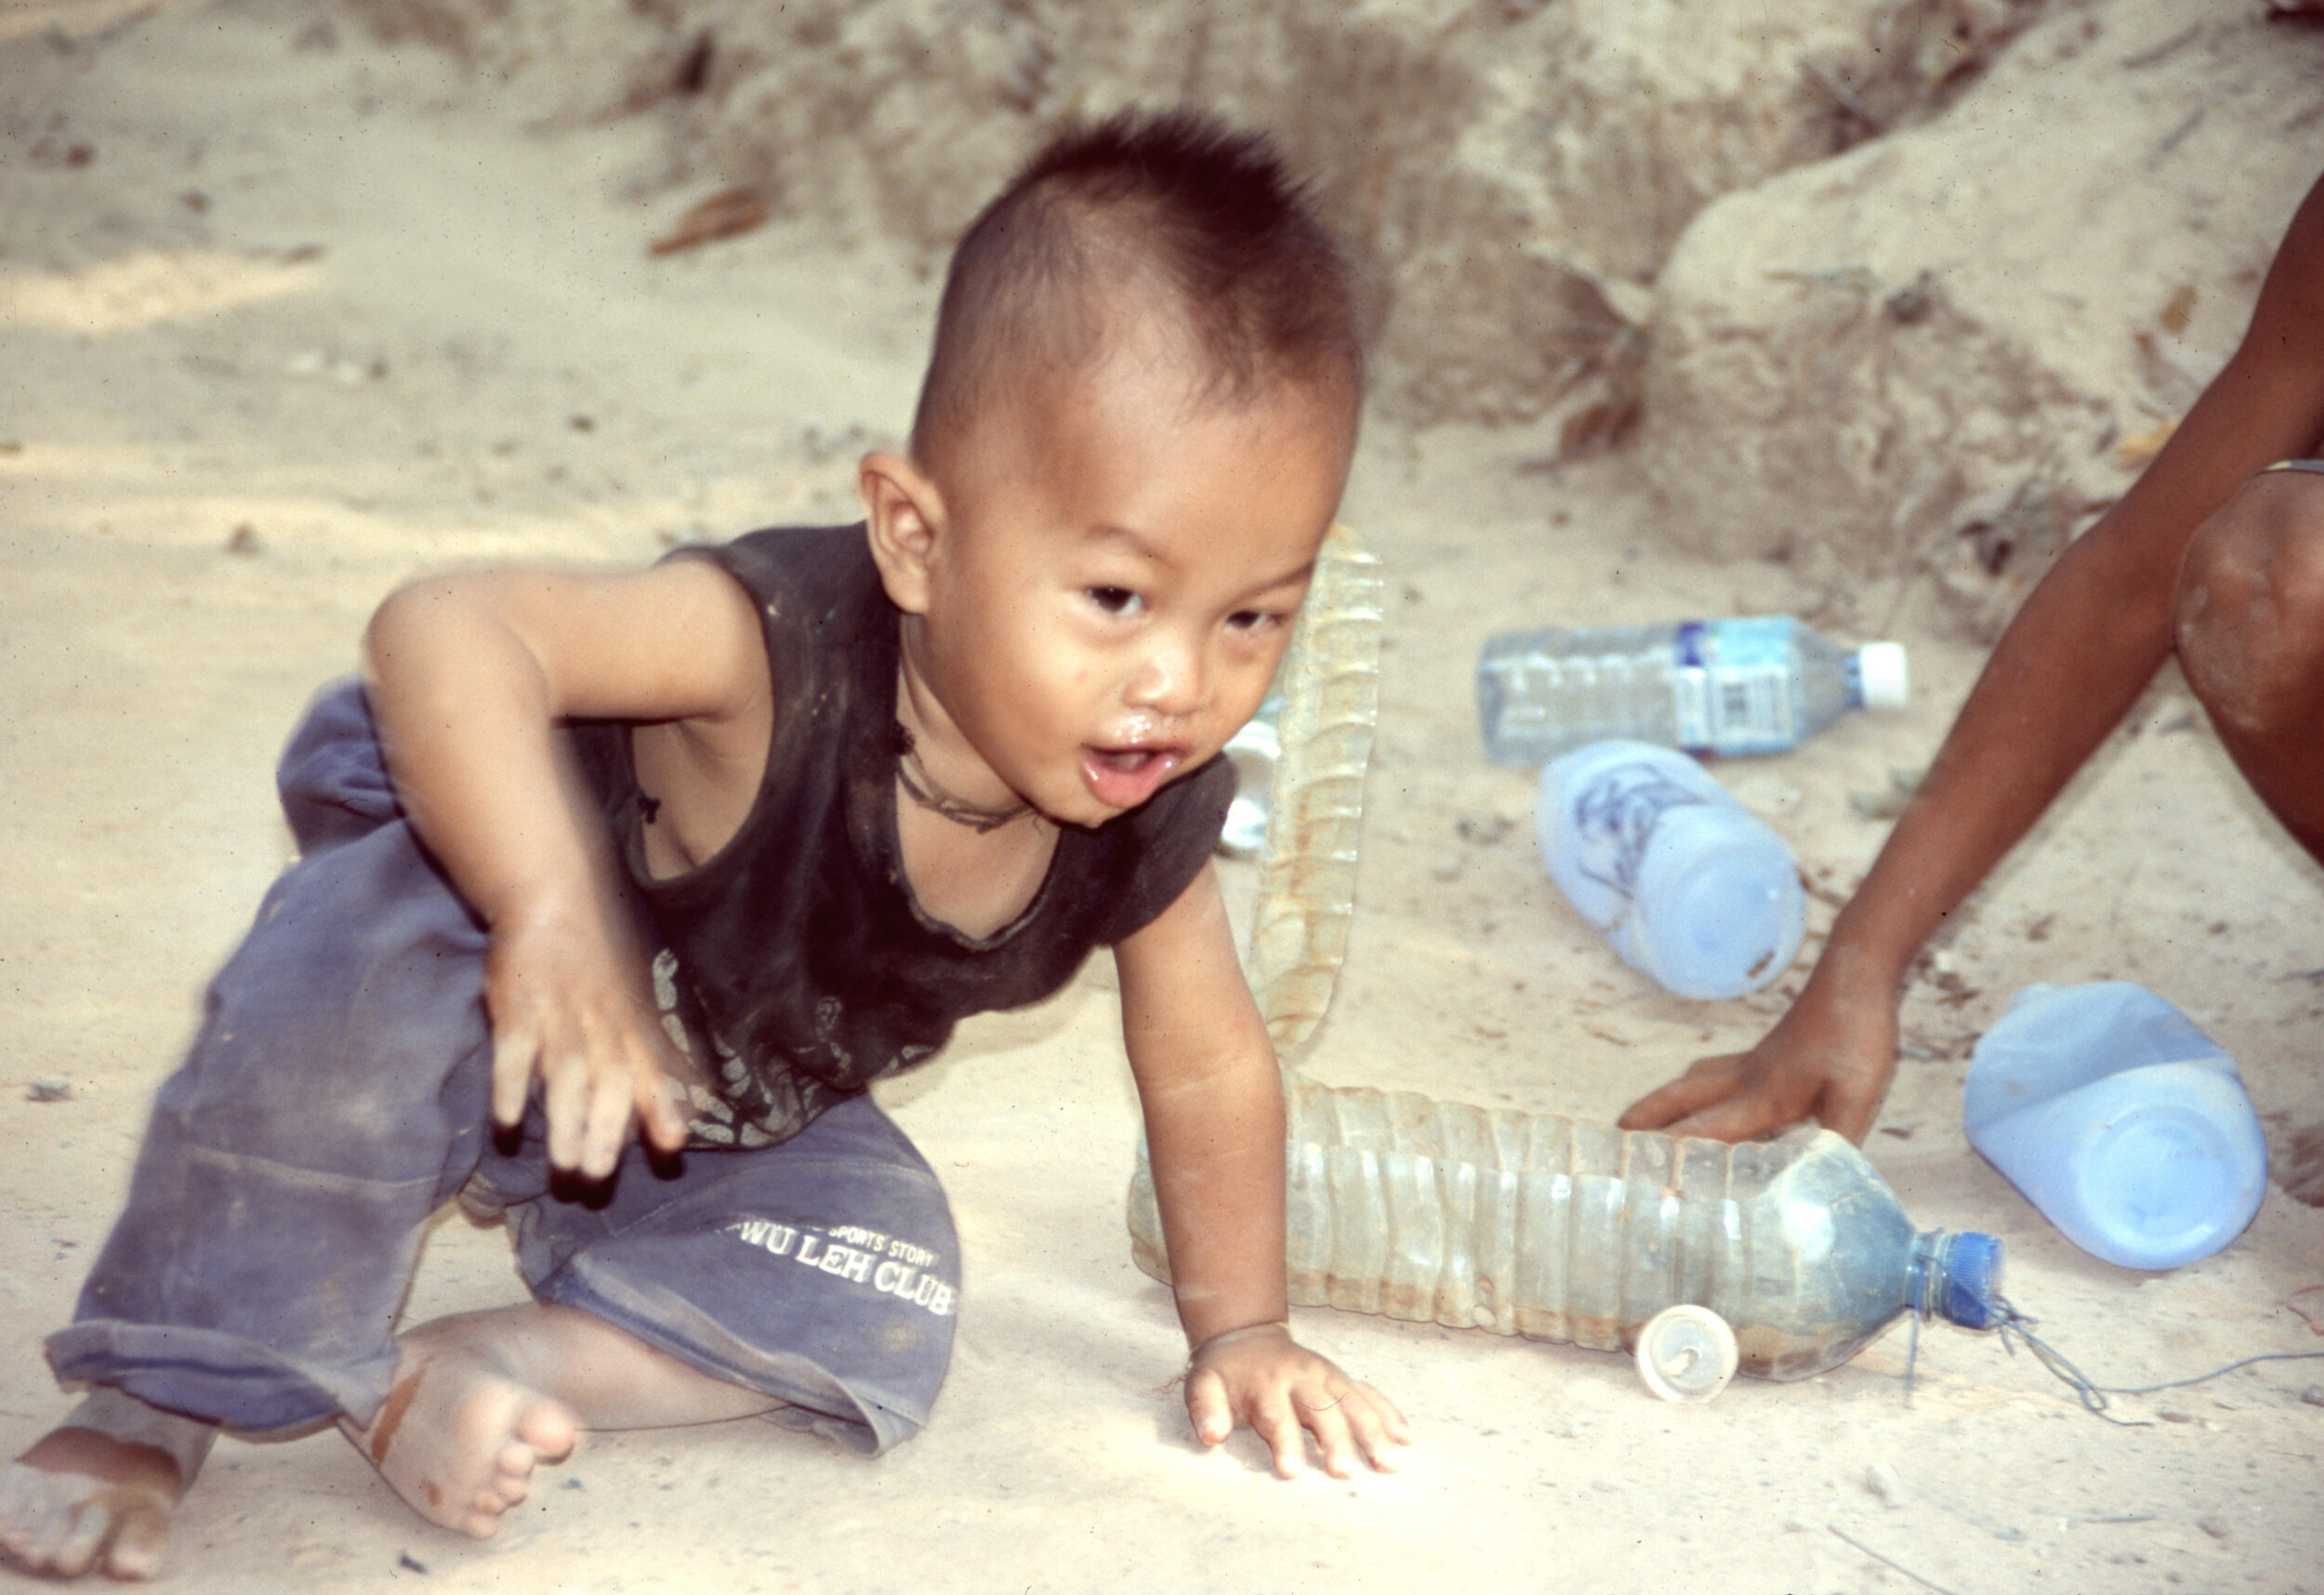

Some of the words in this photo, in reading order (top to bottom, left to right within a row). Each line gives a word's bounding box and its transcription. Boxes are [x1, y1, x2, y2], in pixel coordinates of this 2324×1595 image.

[725, 1220, 798, 1255] WU
[796, 1234, 872, 1283] LEH
[874, 1260, 955, 1316] CLUB
[828, 1226, 885, 1252] SPORTS
[888, 1240, 933, 1267] STORY
